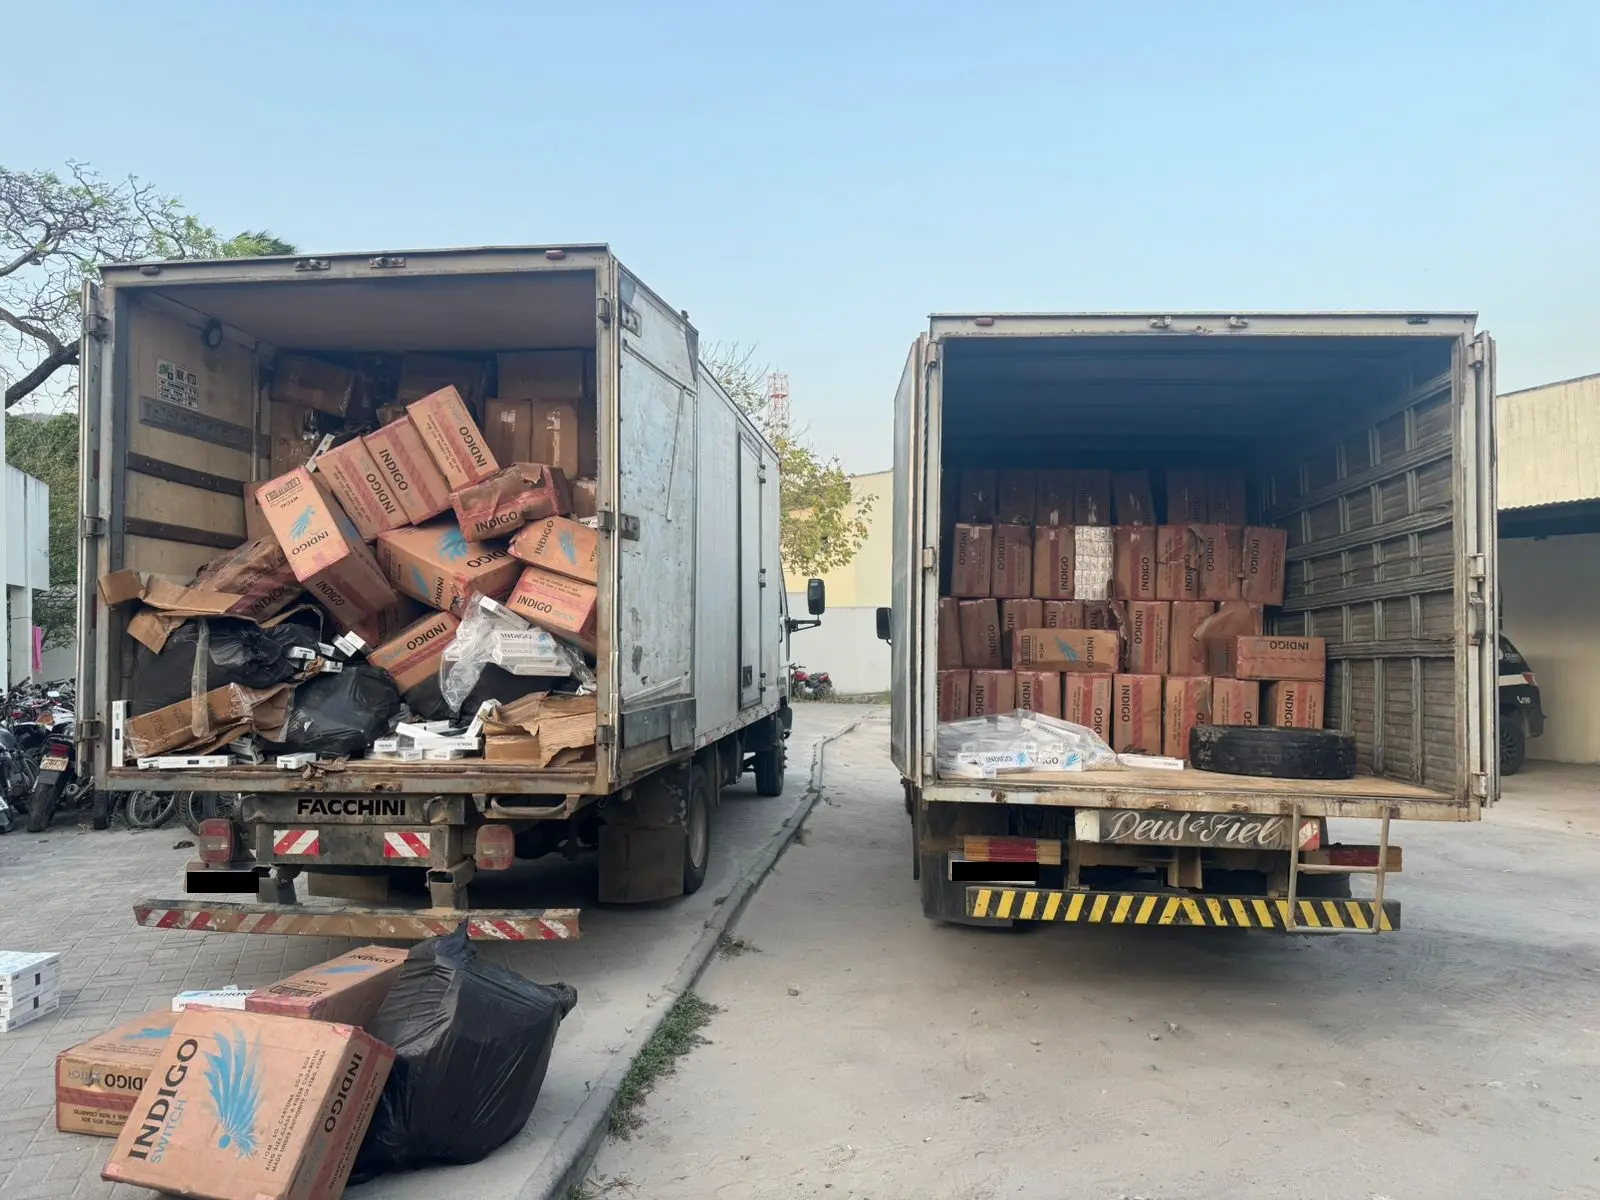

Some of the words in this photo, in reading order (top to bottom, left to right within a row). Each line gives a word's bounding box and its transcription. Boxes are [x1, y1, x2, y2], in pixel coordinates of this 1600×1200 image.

[458, 426, 487, 467] INDIGO
[379, 449, 408, 491] INDIGO
[366, 473, 396, 514] INDIGO
[475, 511, 518, 532] INDIGO
[535, 520, 554, 555] INDIGO
[292, 531, 328, 555] INDIGO
[467, 550, 507, 568] DIGO
[1207, 538, 1215, 572] INDIGO
[1250, 540, 1260, 574] INDIGO
[1142, 557, 1150, 591] INDIGO
[316, 581, 344, 606] INDIGO
[517, 595, 552, 613] INDIGO
[407, 622, 448, 650] INDIGO
[1134, 610, 1142, 644] INDIGO
[1270, 640, 1308, 650] INDIGO
[976, 686, 984, 717] INDIG
[1022, 682, 1032, 710] INDIG
[1122, 685, 1130, 722] INDIGO
[1094, 708, 1102, 737] DIGO
[298, 799, 406, 816] FACCHINI
[1104, 811, 1190, 841] Deus
[1200, 814, 1285, 844] Fiel
[350, 954, 396, 964] INDIGO
[104, 1074, 146, 1090] DIGO
[324, 1052, 362, 1133] INDIGO
[128, 1038, 198, 1160] INDIGO
[150, 1098, 187, 1163] SWITCH
